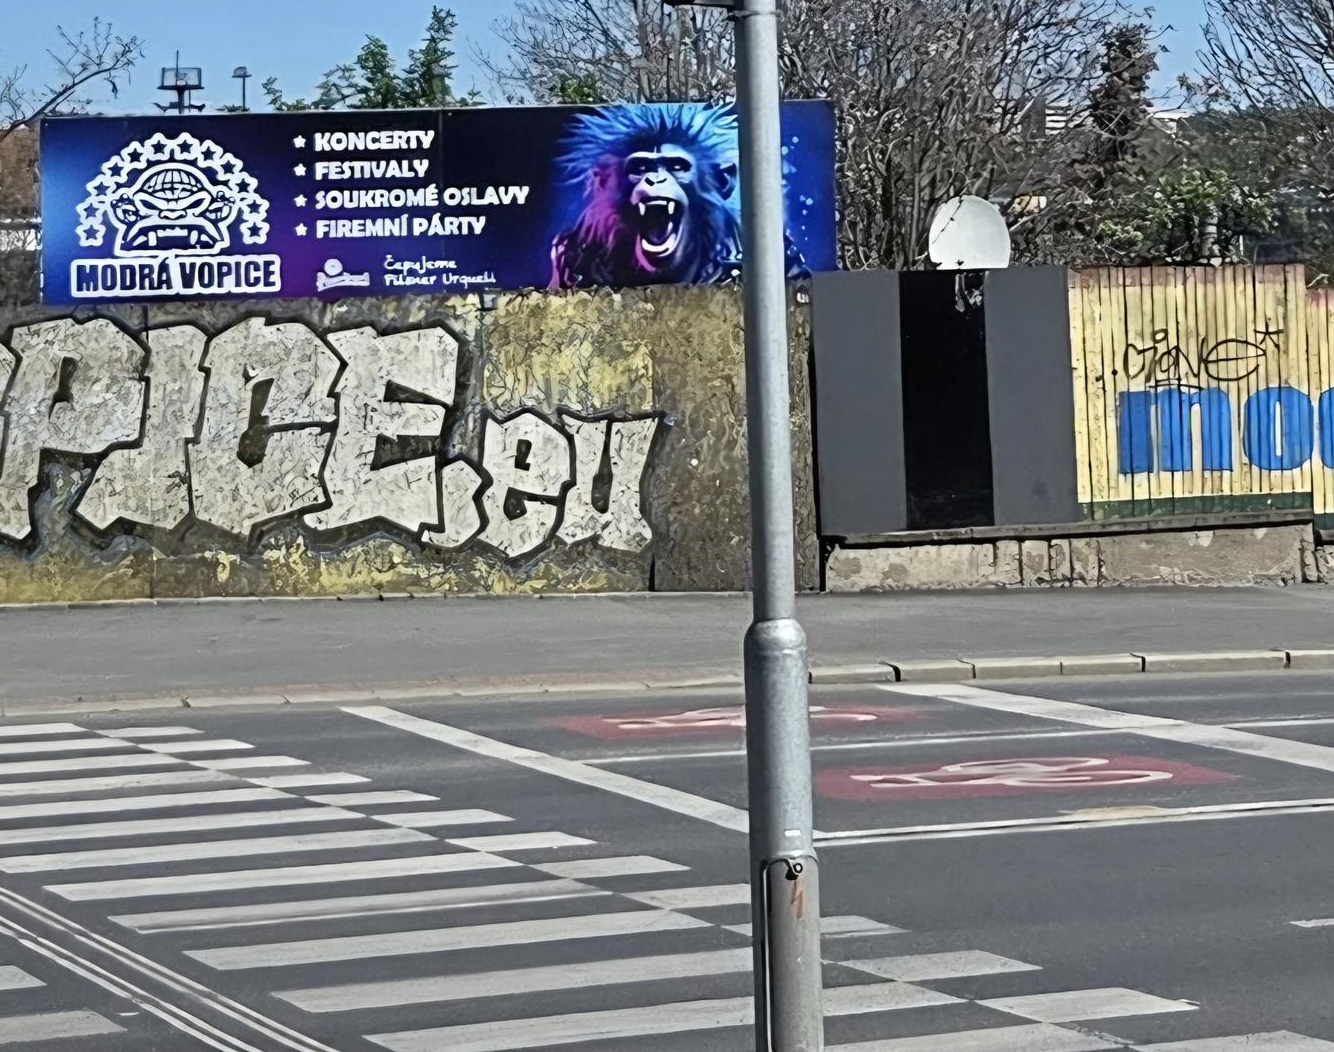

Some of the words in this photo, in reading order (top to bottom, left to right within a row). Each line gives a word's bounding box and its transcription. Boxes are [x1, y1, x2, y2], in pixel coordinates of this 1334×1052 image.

[314, 130, 435, 152] KONCERTY
[314, 159, 429, 180] FESTIVALY
[315, 184, 439, 209] SOUKROMÉ
[443, 186, 530, 206] OSLAVY
[316, 214, 409, 239] FIREMNÍ
[412, 213, 486, 236] PÁRTY
[75, 254, 174, 292] MODRÁ
[178, 260, 276, 289] VOPICE
